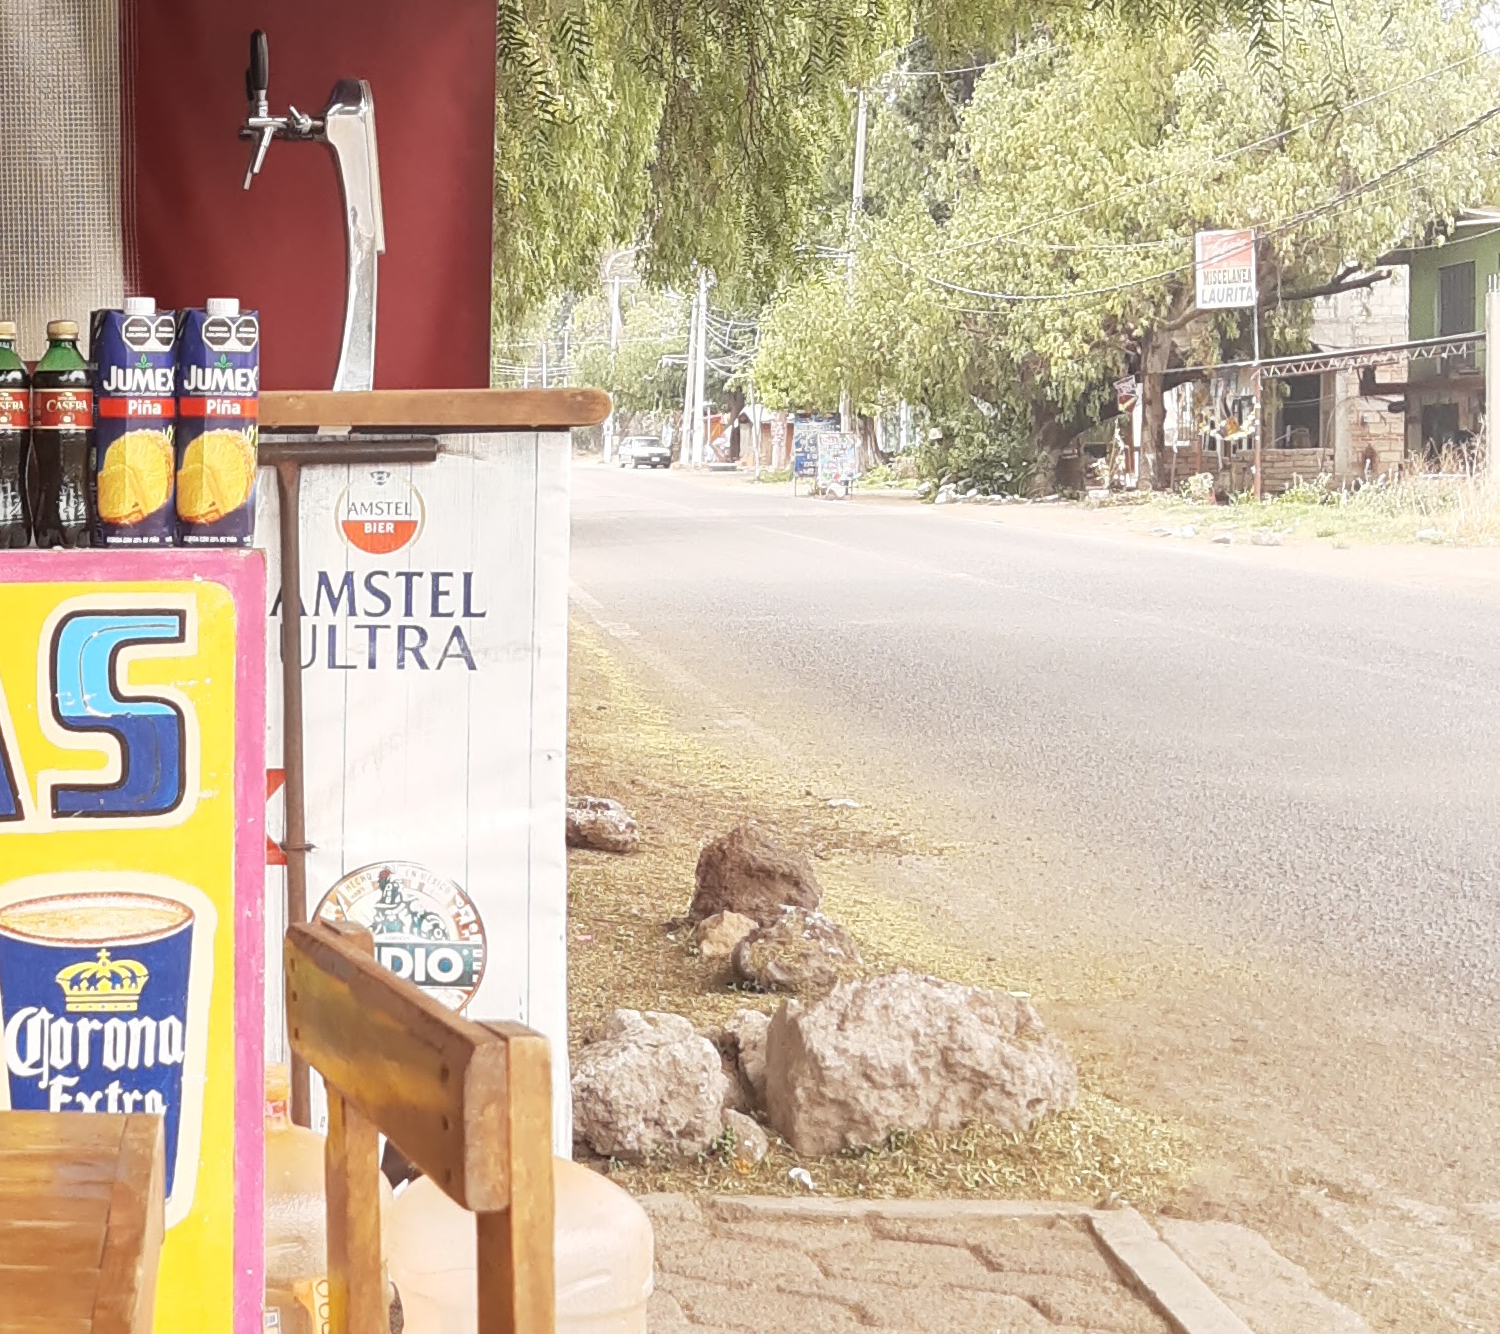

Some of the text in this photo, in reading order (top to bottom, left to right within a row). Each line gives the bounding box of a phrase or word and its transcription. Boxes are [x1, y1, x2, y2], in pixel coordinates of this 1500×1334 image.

[1203, 268, 1252, 285] MISCELANEA
[1201, 286, 1254, 304] LAURITA
[103, 366, 175, 392] JUMEX
[184, 365, 259, 392] JUMEX
[128, 398, 162, 415] Piña
[206, 398, 241, 415] Piña
[348, 501, 412, 516] AMSTEL
[364, 522, 395, 534] BIER
[345, 872, 372, 892] HECHO
[405, 869, 417, 878] EN
[374, 946, 464, 983] DIO
[4, 1006, 185, 1089] Corona
[48, 1074, 168, 1114] Extra
